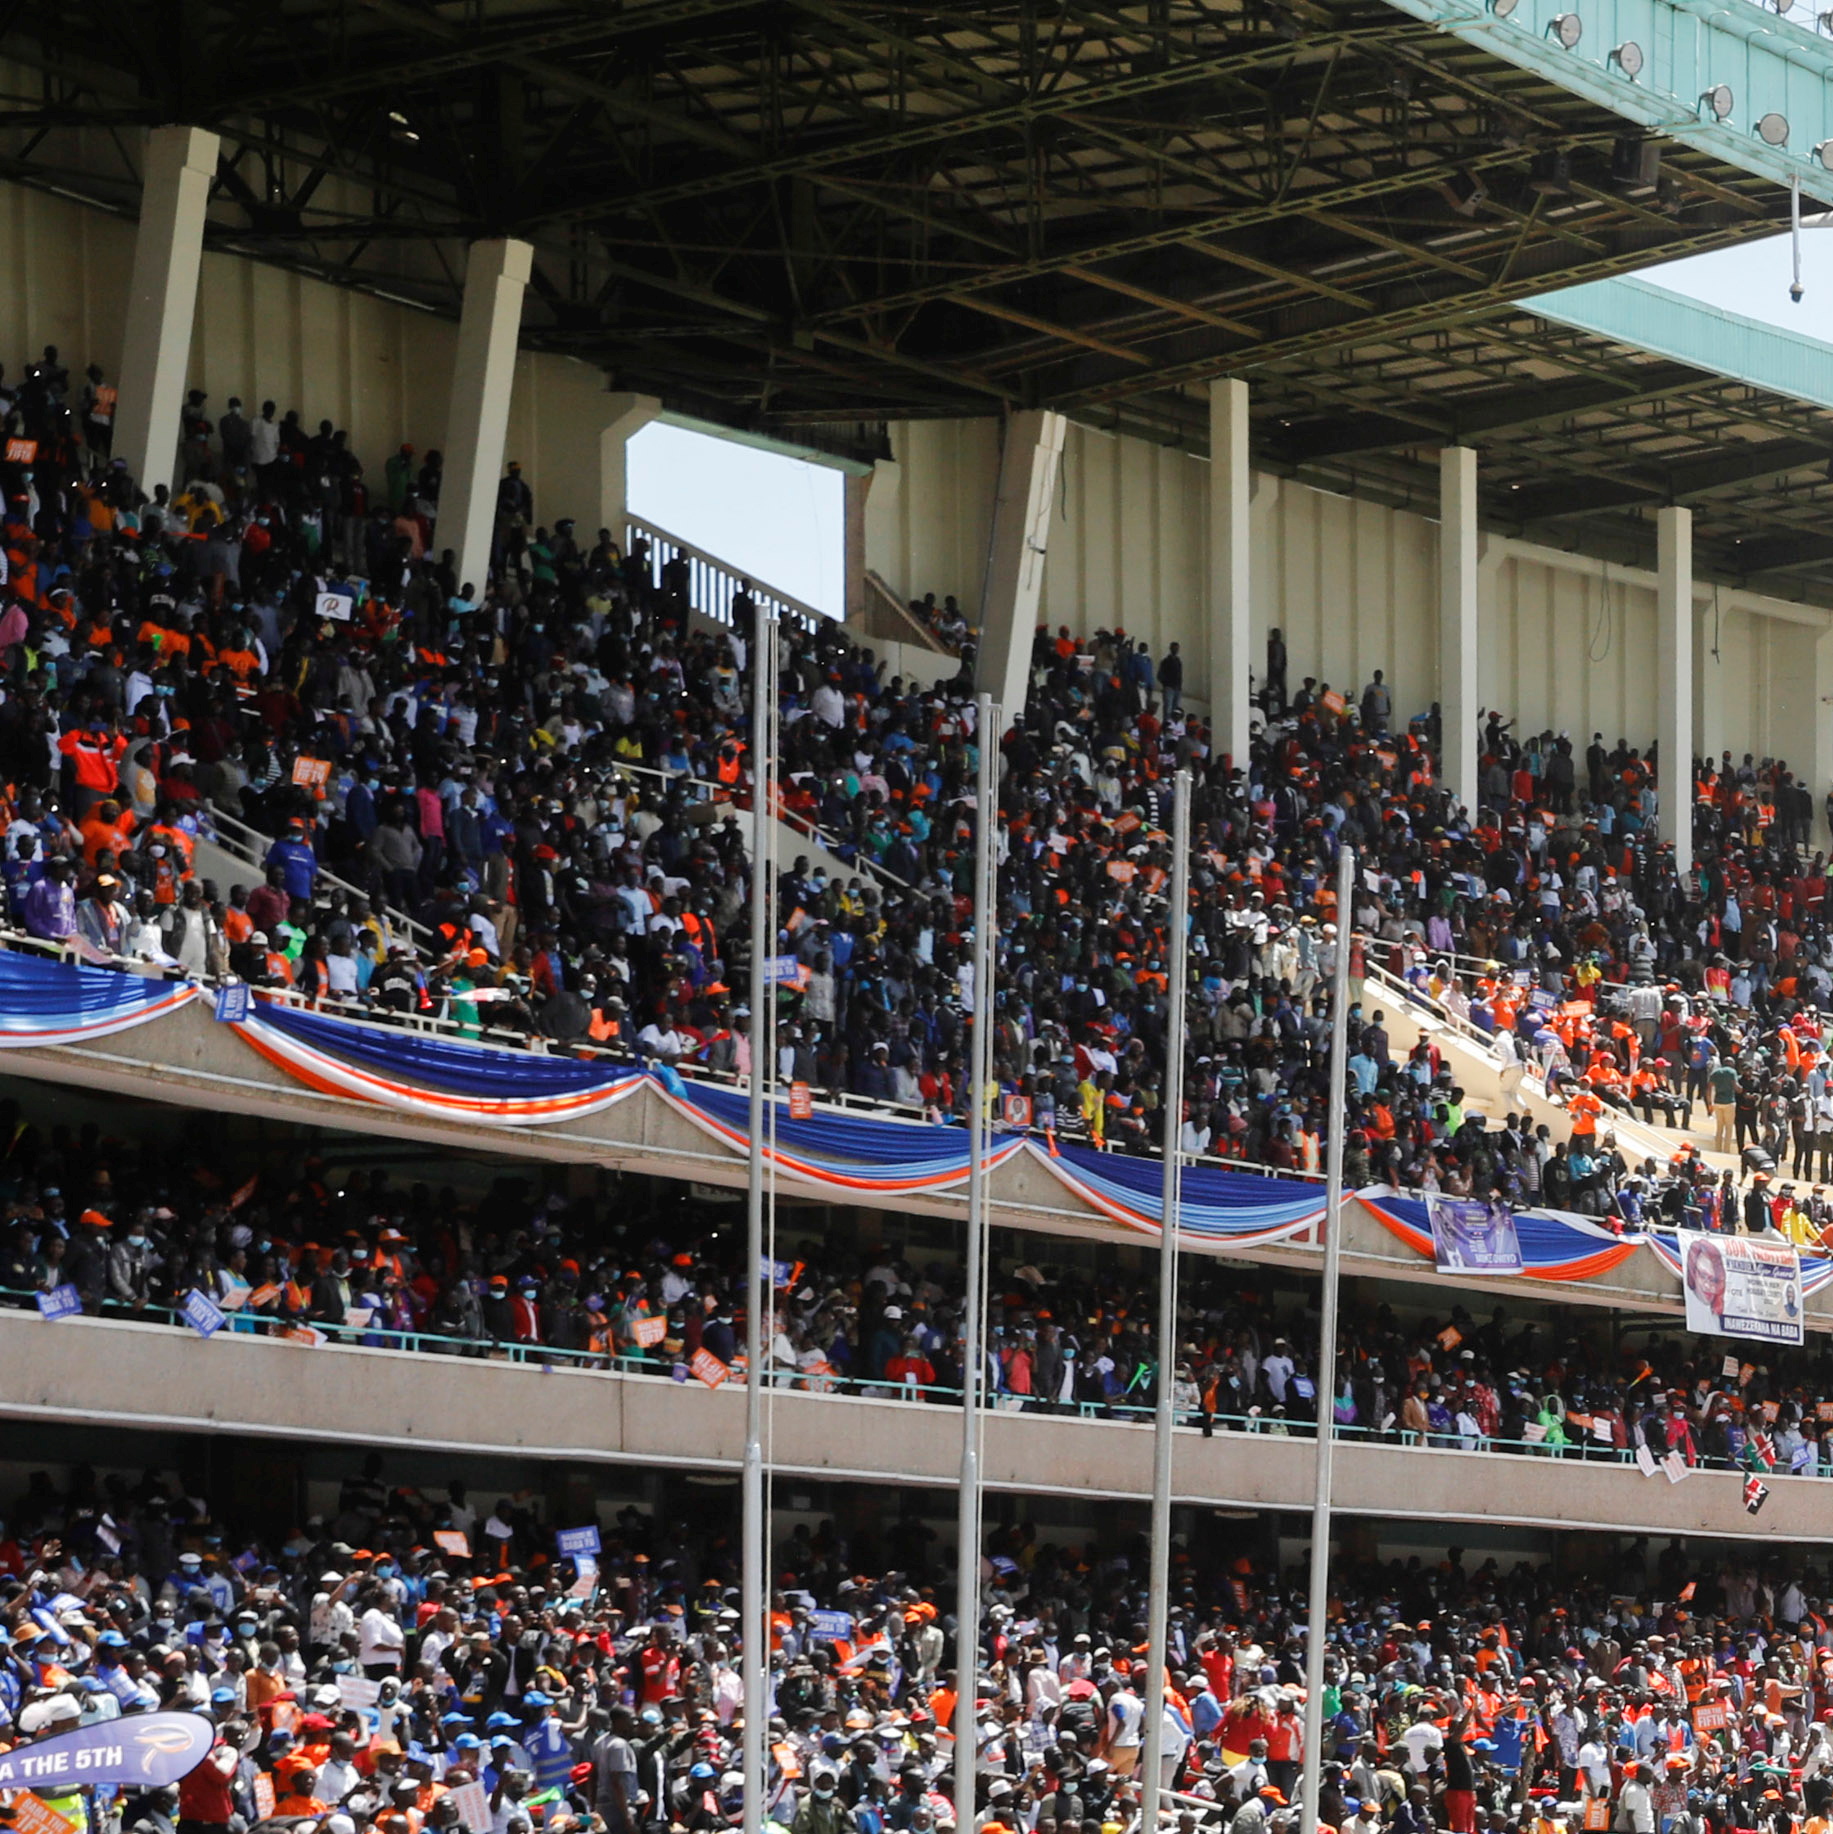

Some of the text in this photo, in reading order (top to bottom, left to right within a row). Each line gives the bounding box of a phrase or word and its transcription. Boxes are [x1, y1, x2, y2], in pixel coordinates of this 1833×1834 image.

[1698, 1714, 1725, 1728] FIFTH
[21, 1752, 69, 1777] THE
[75, 1747, 122, 1769] 5TH
[48, 1813, 69, 1833] THE
